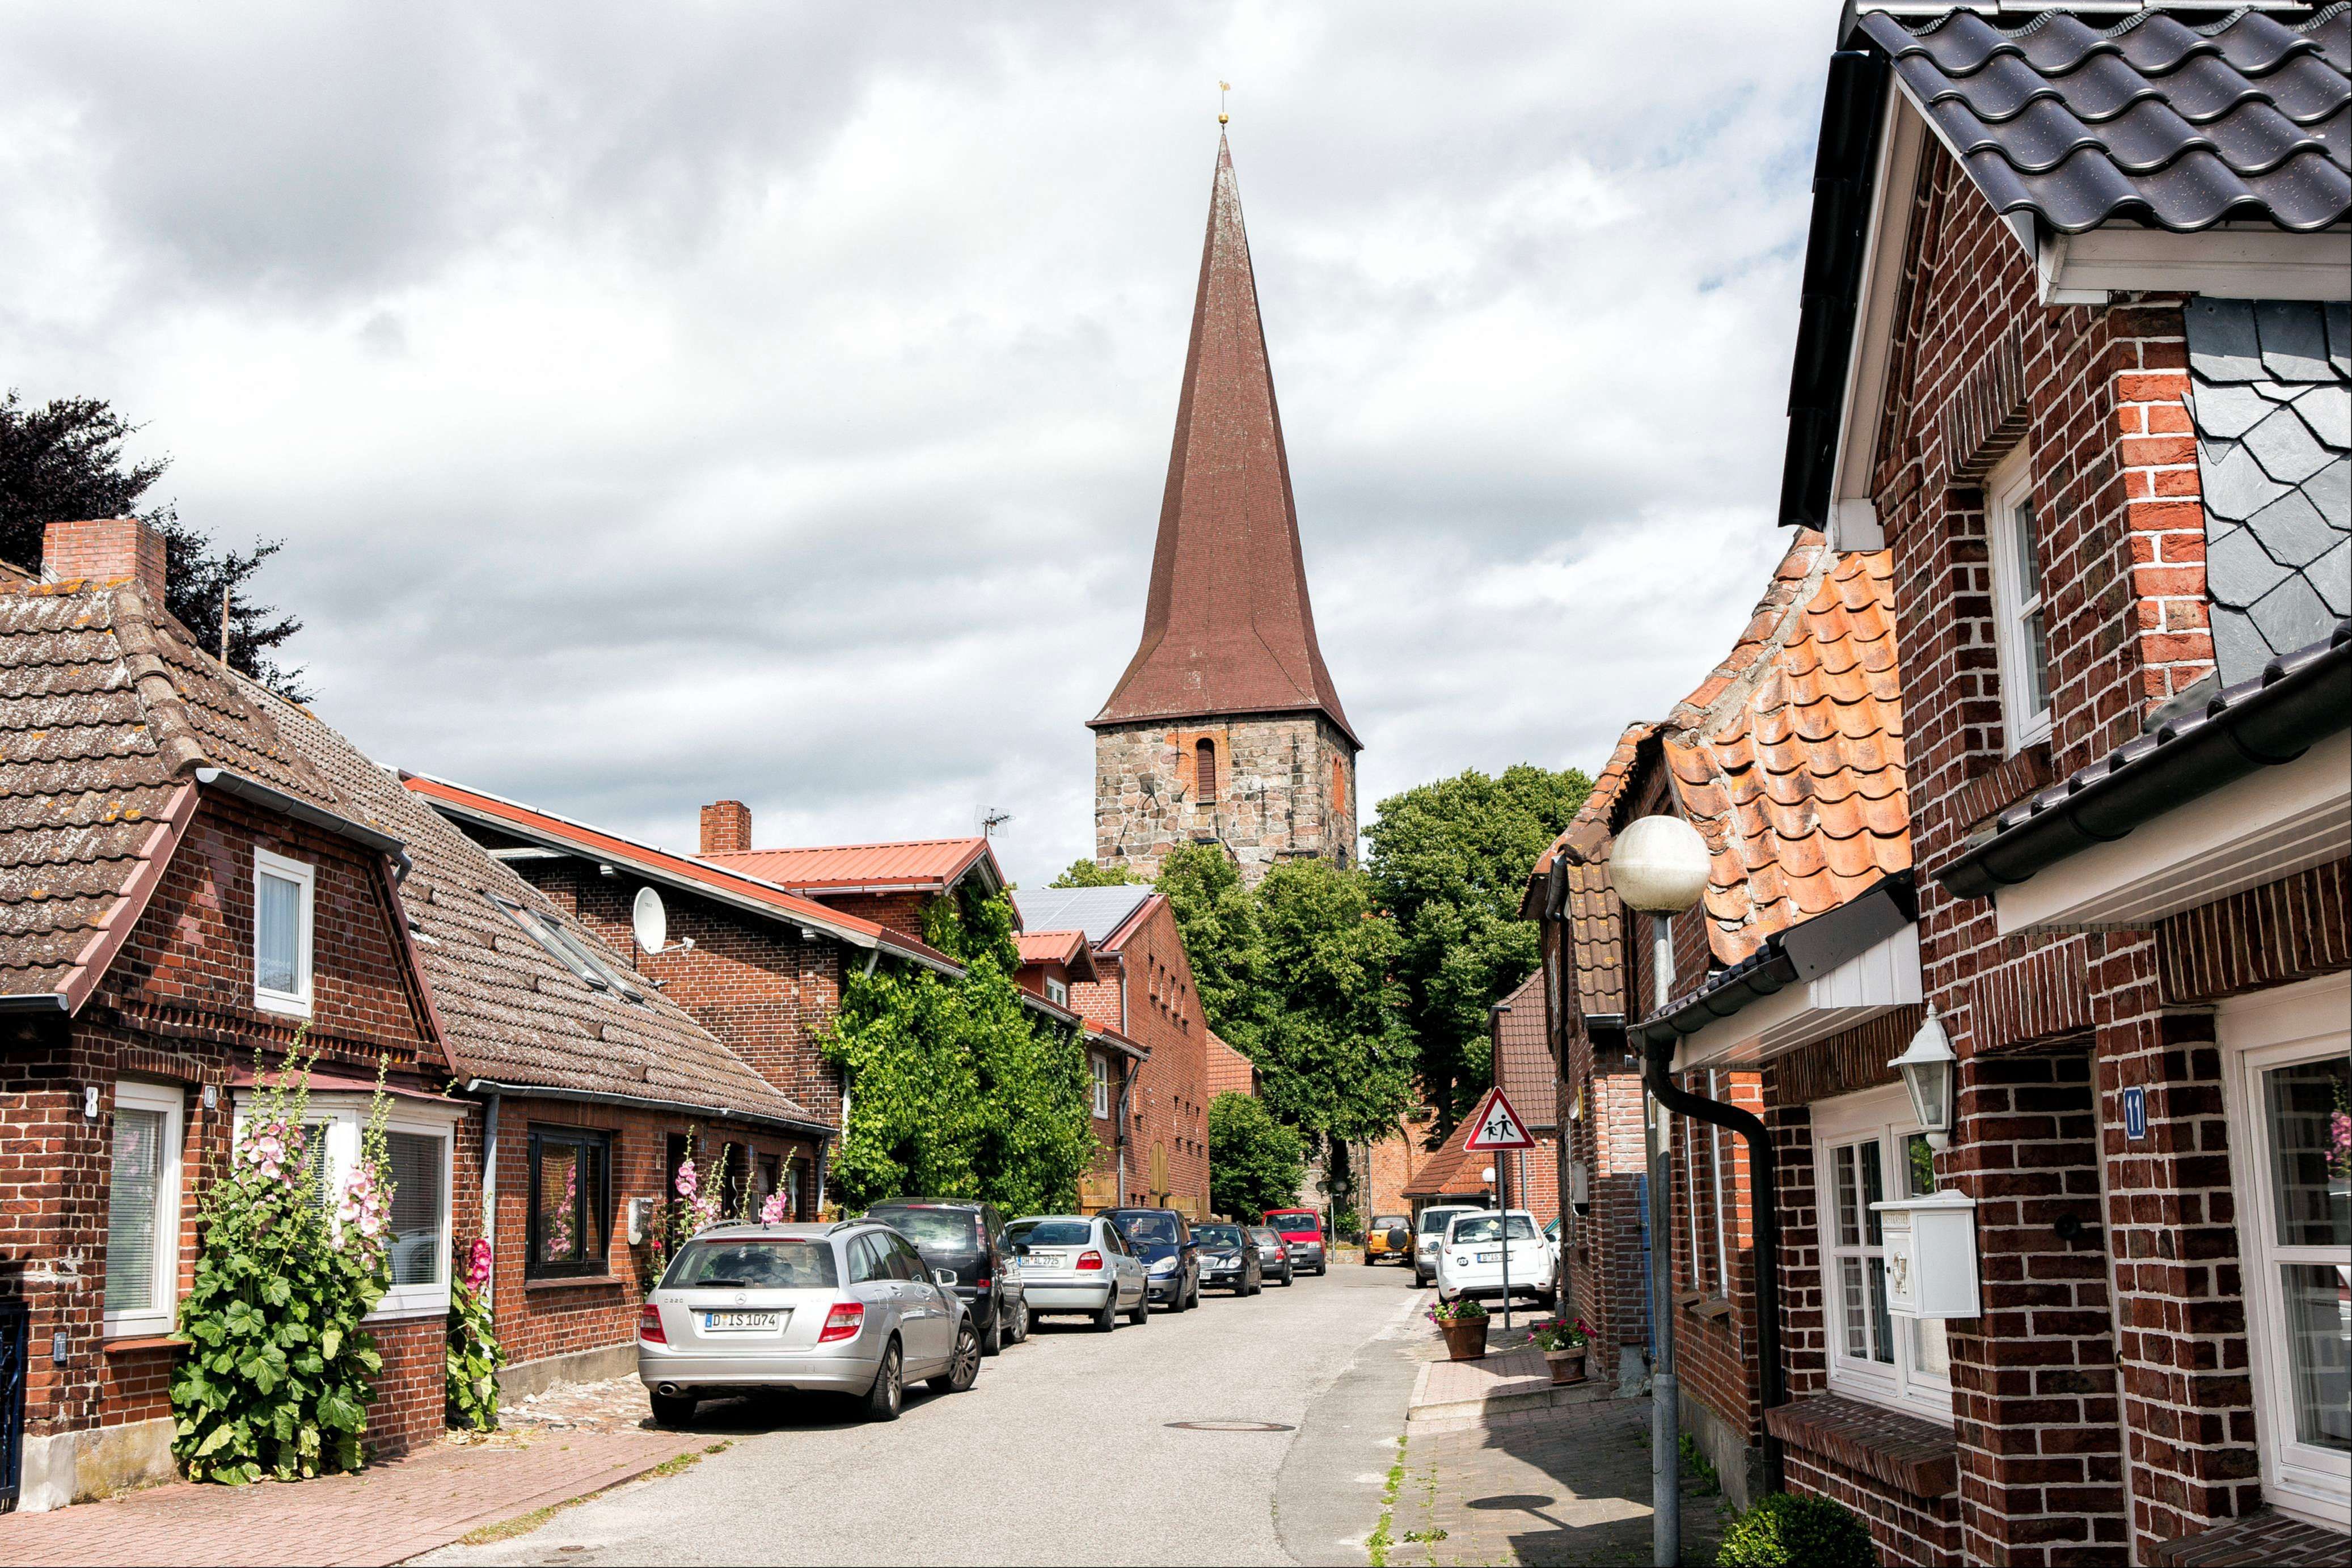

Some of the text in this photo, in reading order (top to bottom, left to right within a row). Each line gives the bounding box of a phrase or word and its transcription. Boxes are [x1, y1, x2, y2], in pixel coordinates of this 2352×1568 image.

[85, 1087, 99, 1118] 8
[208, 1089, 213, 1104] 8
[2127, 1094, 2141, 1131] 11
[713, 1314, 776, 1326] D IS 1074
